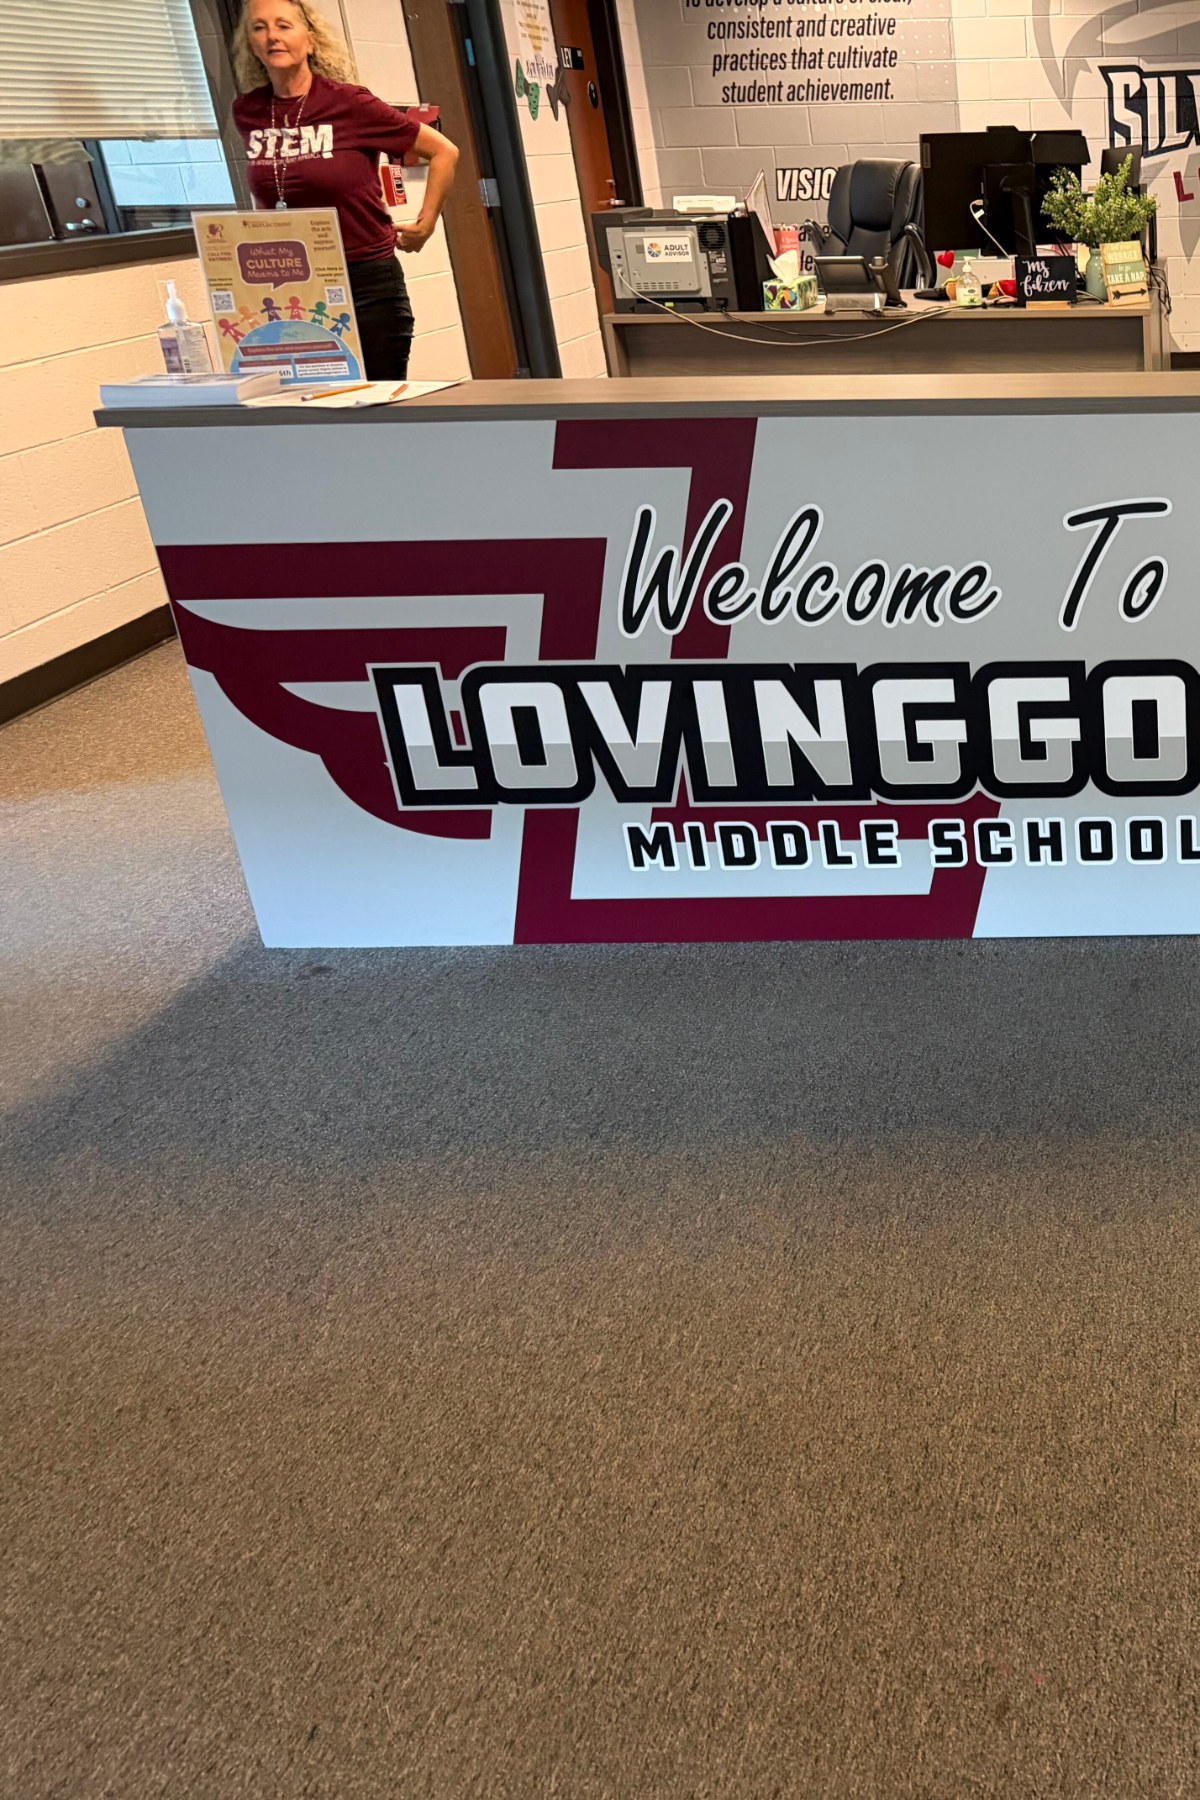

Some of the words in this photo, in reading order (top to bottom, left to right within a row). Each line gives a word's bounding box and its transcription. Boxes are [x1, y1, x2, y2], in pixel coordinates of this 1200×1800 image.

[707, 14, 792, 39] consistent
[796, 13, 827, 38] and
[830, 12, 897, 37] creative
[712, 47, 787, 77] practices
[791, 46, 823, 70] that
[827, 45, 898, 69] cultivate
[721, 80, 783, 104] student
[787, 78, 894, 102] achievement.
[246, 124, 334, 160] STEM
[776, 168, 838, 201] VISIO
[277, 246, 294, 257] My
[664, 243, 689, 252] ADULT
[246, 257, 303, 269] CULTURE
[1106, 273, 1124, 285] TAKE
[1124, 272, 1131, 283] A
[618, 499, 1001, 638] Welcome
[1060, 497, 1172, 632] To
[624, 819, 901, 870] MIDDLE
